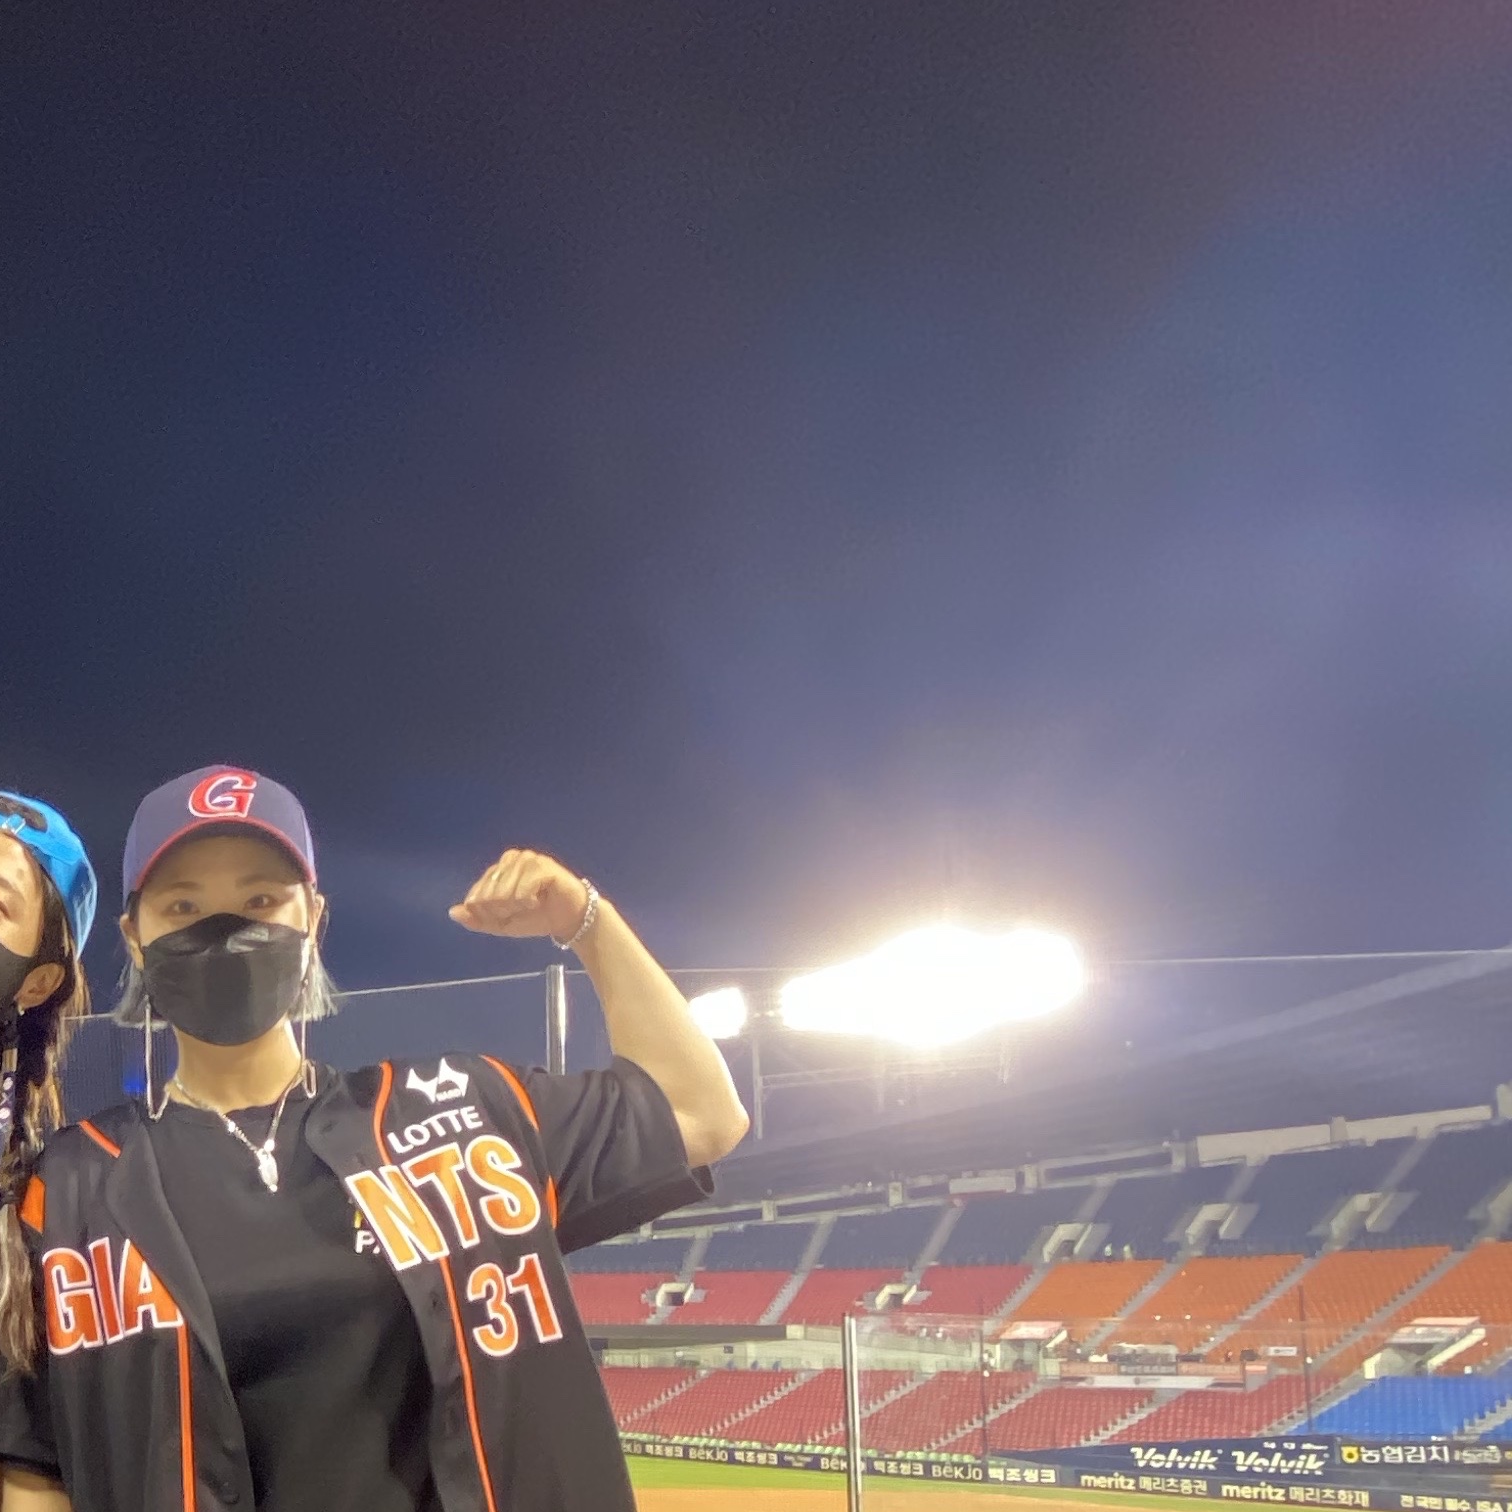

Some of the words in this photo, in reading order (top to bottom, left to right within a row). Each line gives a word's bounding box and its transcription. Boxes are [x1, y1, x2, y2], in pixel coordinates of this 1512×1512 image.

[189, 769, 257, 817] G
[387, 1105, 484, 1154] LOTTE
[344, 1134, 541, 1272] NTS
[42, 1236, 184, 1356] GIA
[466, 1252, 564, 1357] 31
[1130, 1446, 1219, 1471] Volvik
[1231, 1450, 1326, 1476] Volvik
[1359, 1445, 1451, 1464] 농협김치
[988, 1466, 1057, 1484] 백조씽크
[1080, 1471, 1137, 1491] meritz
[1139, 1475, 1208, 1496] 메리츠증권
[1221, 1481, 1286, 1502] meritz
[1288, 1485, 1370, 1508] 메리츠화재
